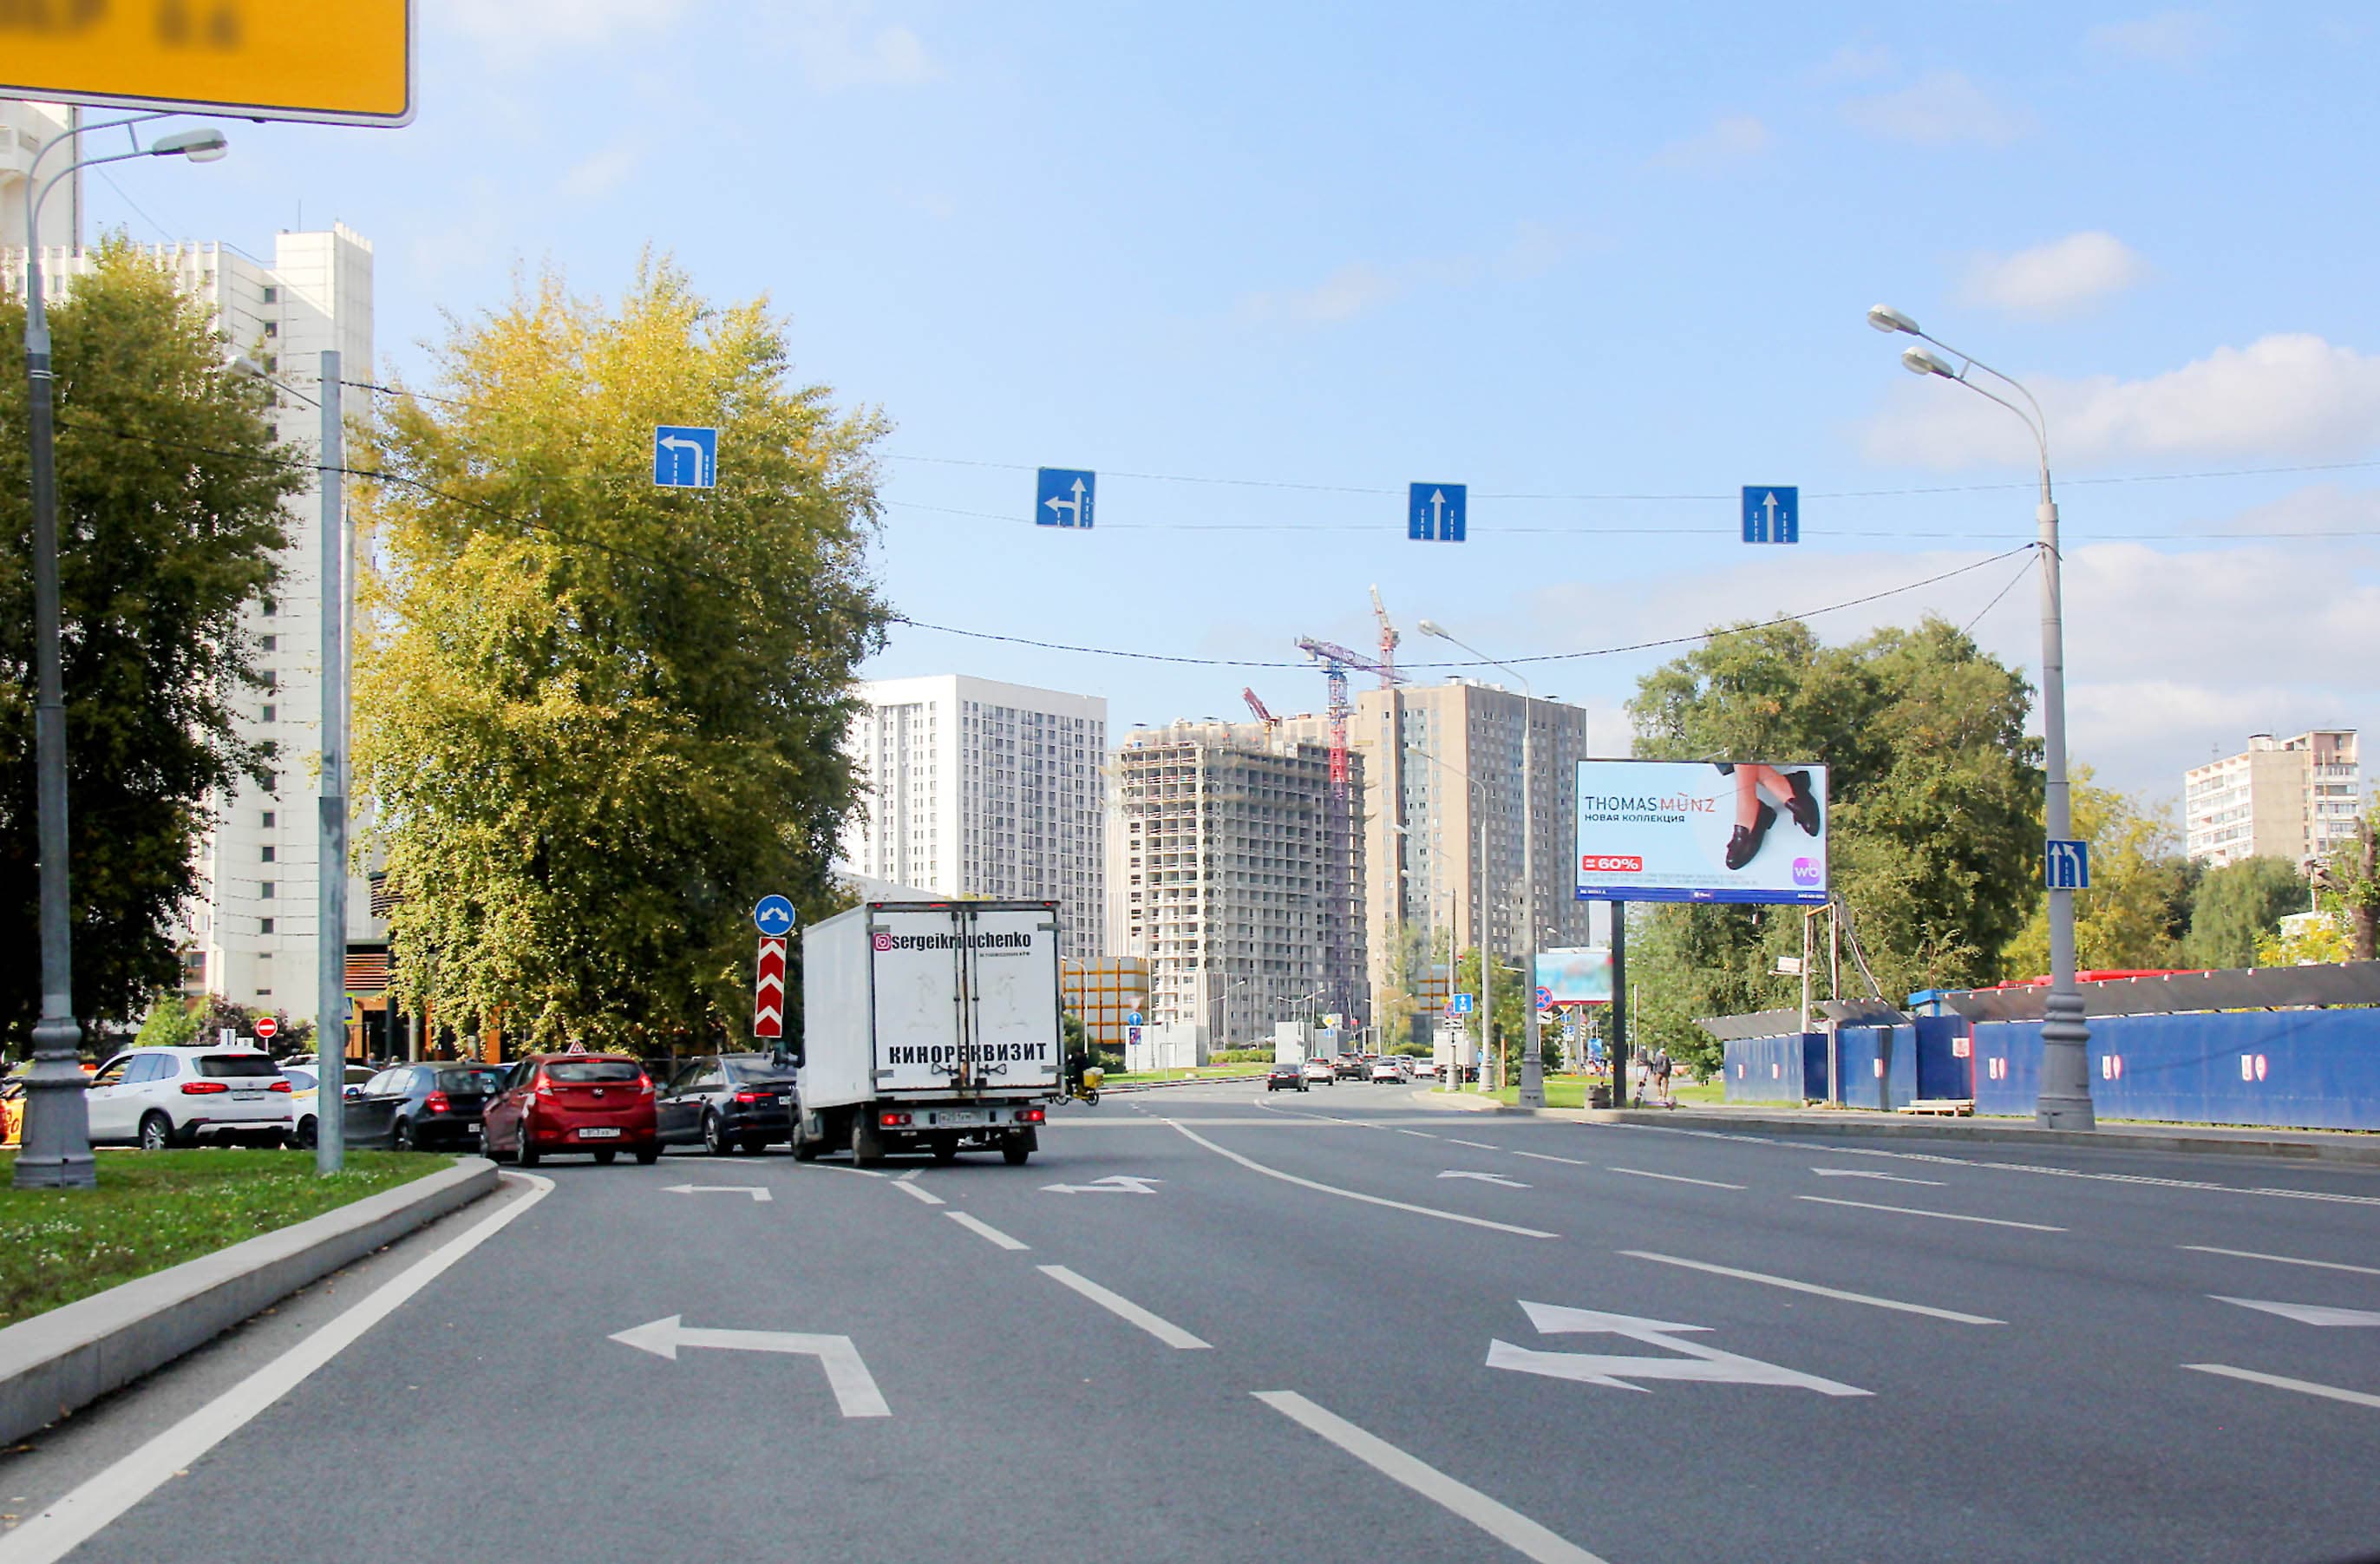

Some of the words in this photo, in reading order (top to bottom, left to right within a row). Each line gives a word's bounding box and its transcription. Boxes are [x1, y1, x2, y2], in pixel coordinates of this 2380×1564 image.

[1585, 796, 1658, 811] THOMAS
[1622, 814, 1685, 823] КОЛЛЕКЦИЯ
[889, 1043, 1047, 1064] КИНОРЕКВИЗИТ
